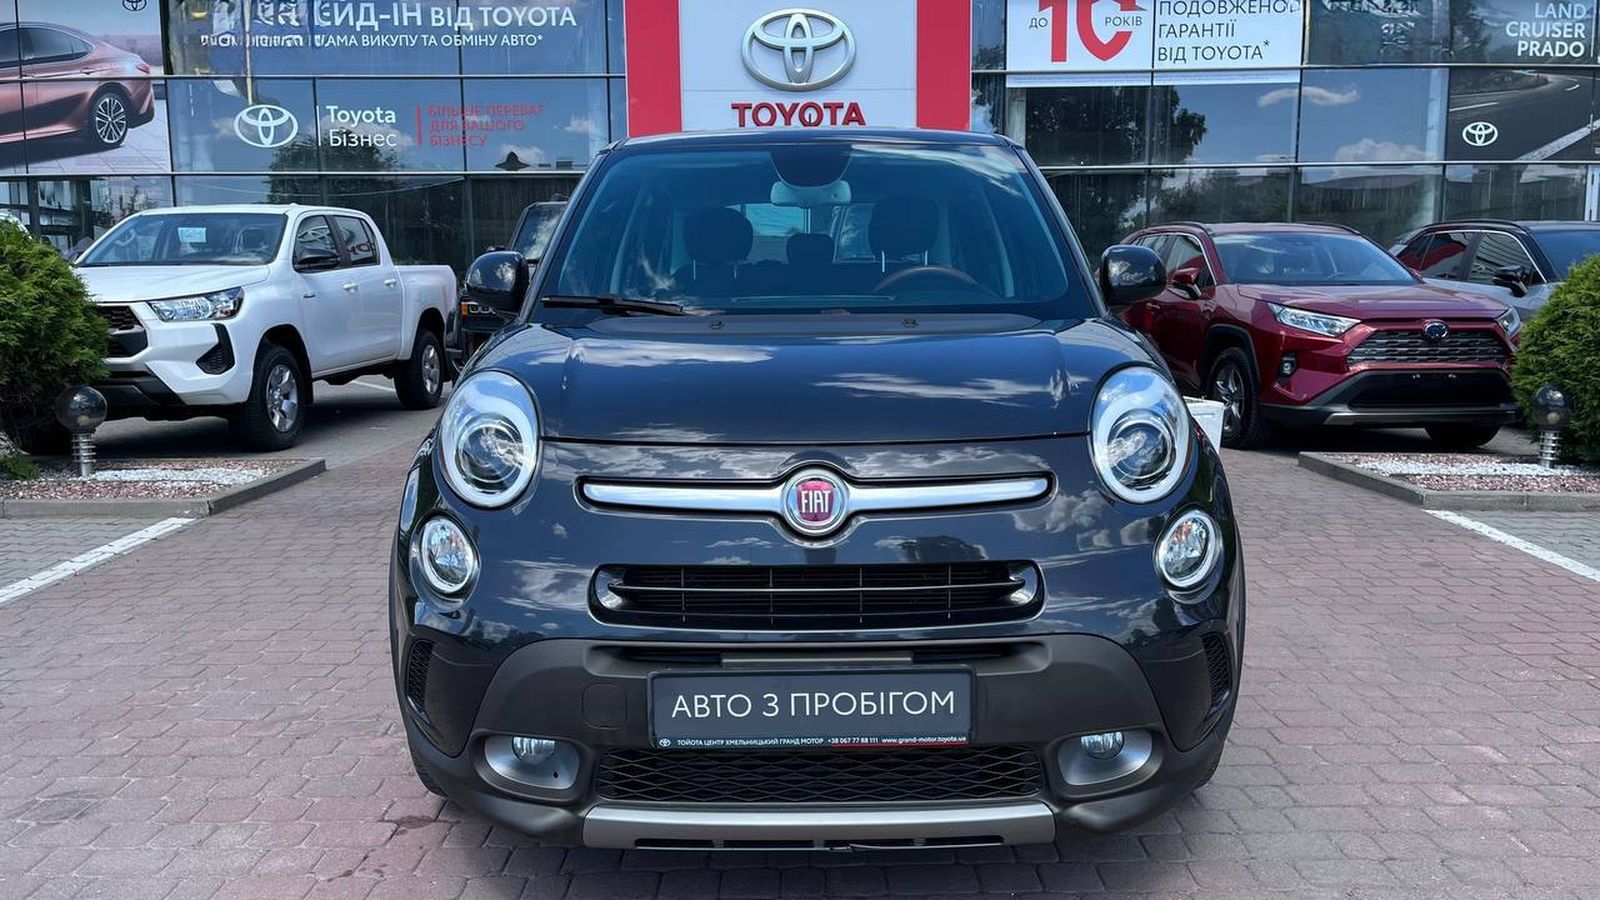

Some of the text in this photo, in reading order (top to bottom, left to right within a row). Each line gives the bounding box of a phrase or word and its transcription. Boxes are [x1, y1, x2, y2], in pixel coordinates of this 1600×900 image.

[430, 7, 473, 31] ВІД
[478, 6, 577, 27] TOYOTA
[1534, 2, 1587, 19] LAND
[1029, 17, 1048, 29] ДО
[1104, 16, 1143, 27] РОКІВ
[1158, 19, 1236, 39] ГАРАНТІЇ
[1505, 20, 1586, 38] CRUISER
[361, 35, 418, 47] ВИКУПУ
[421, 35, 438, 46] ТА
[440, 34, 497, 47] ОБМІНУ
[1517, 40, 1585, 58] PRADO
[1158, 46, 1187, 64] ВІД
[326, 105, 397, 127] Toyota
[731, 102, 866, 127] TOYOTA
[329, 129, 398, 147] Бізнес
[801, 490, 831, 513] FIAT
[671, 690, 955, 718] АВТО З ПРОБІГОМ
[677, 738, 703, 746] ТОЙОТА
[703, 739, 724, 747] ЦЕНТР
[779, 738, 800, 746] ГРАНД
[801, 737, 824, 745] МОТОР
